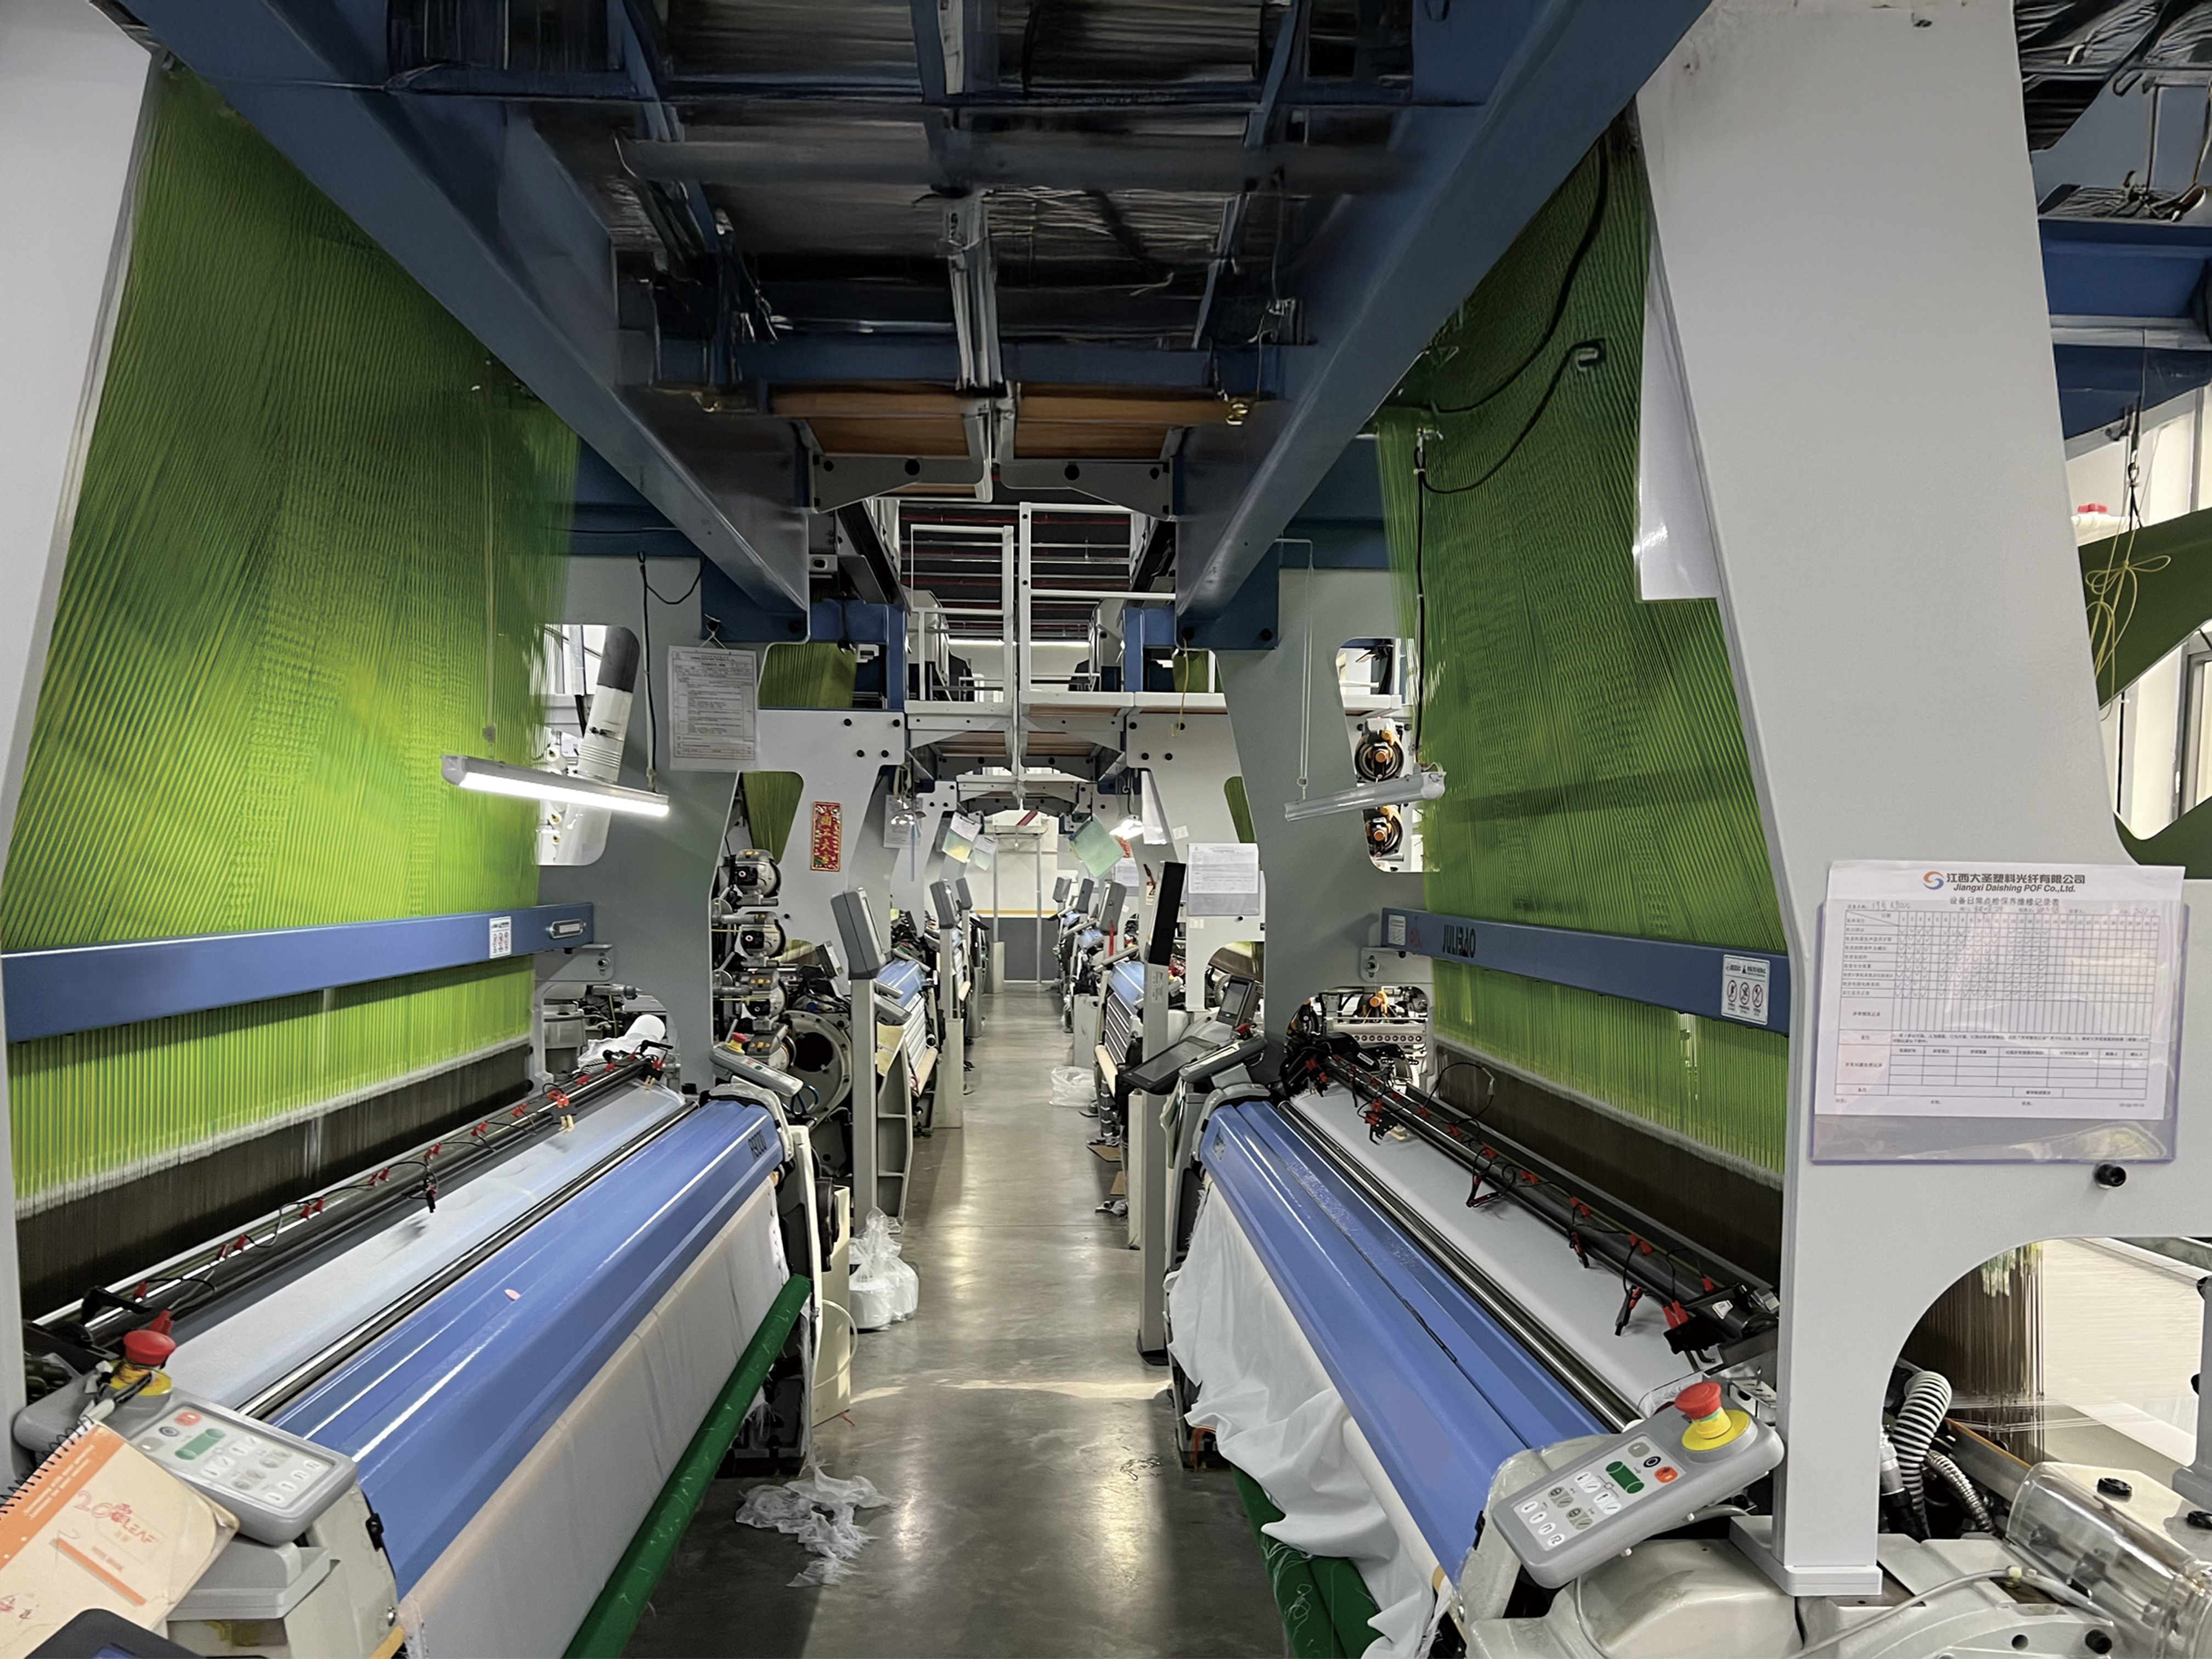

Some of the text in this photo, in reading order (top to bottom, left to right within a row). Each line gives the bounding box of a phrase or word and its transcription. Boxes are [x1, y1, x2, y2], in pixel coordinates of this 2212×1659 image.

[1946, 873, 2085, 884] 江西大圣塑料光纤有限公司
[1954, 883, 1984, 893] Jiangxi
[1985, 884, 2022, 893] Daishing
[2044, 884, 2076, 893] Co.,Ltd.
